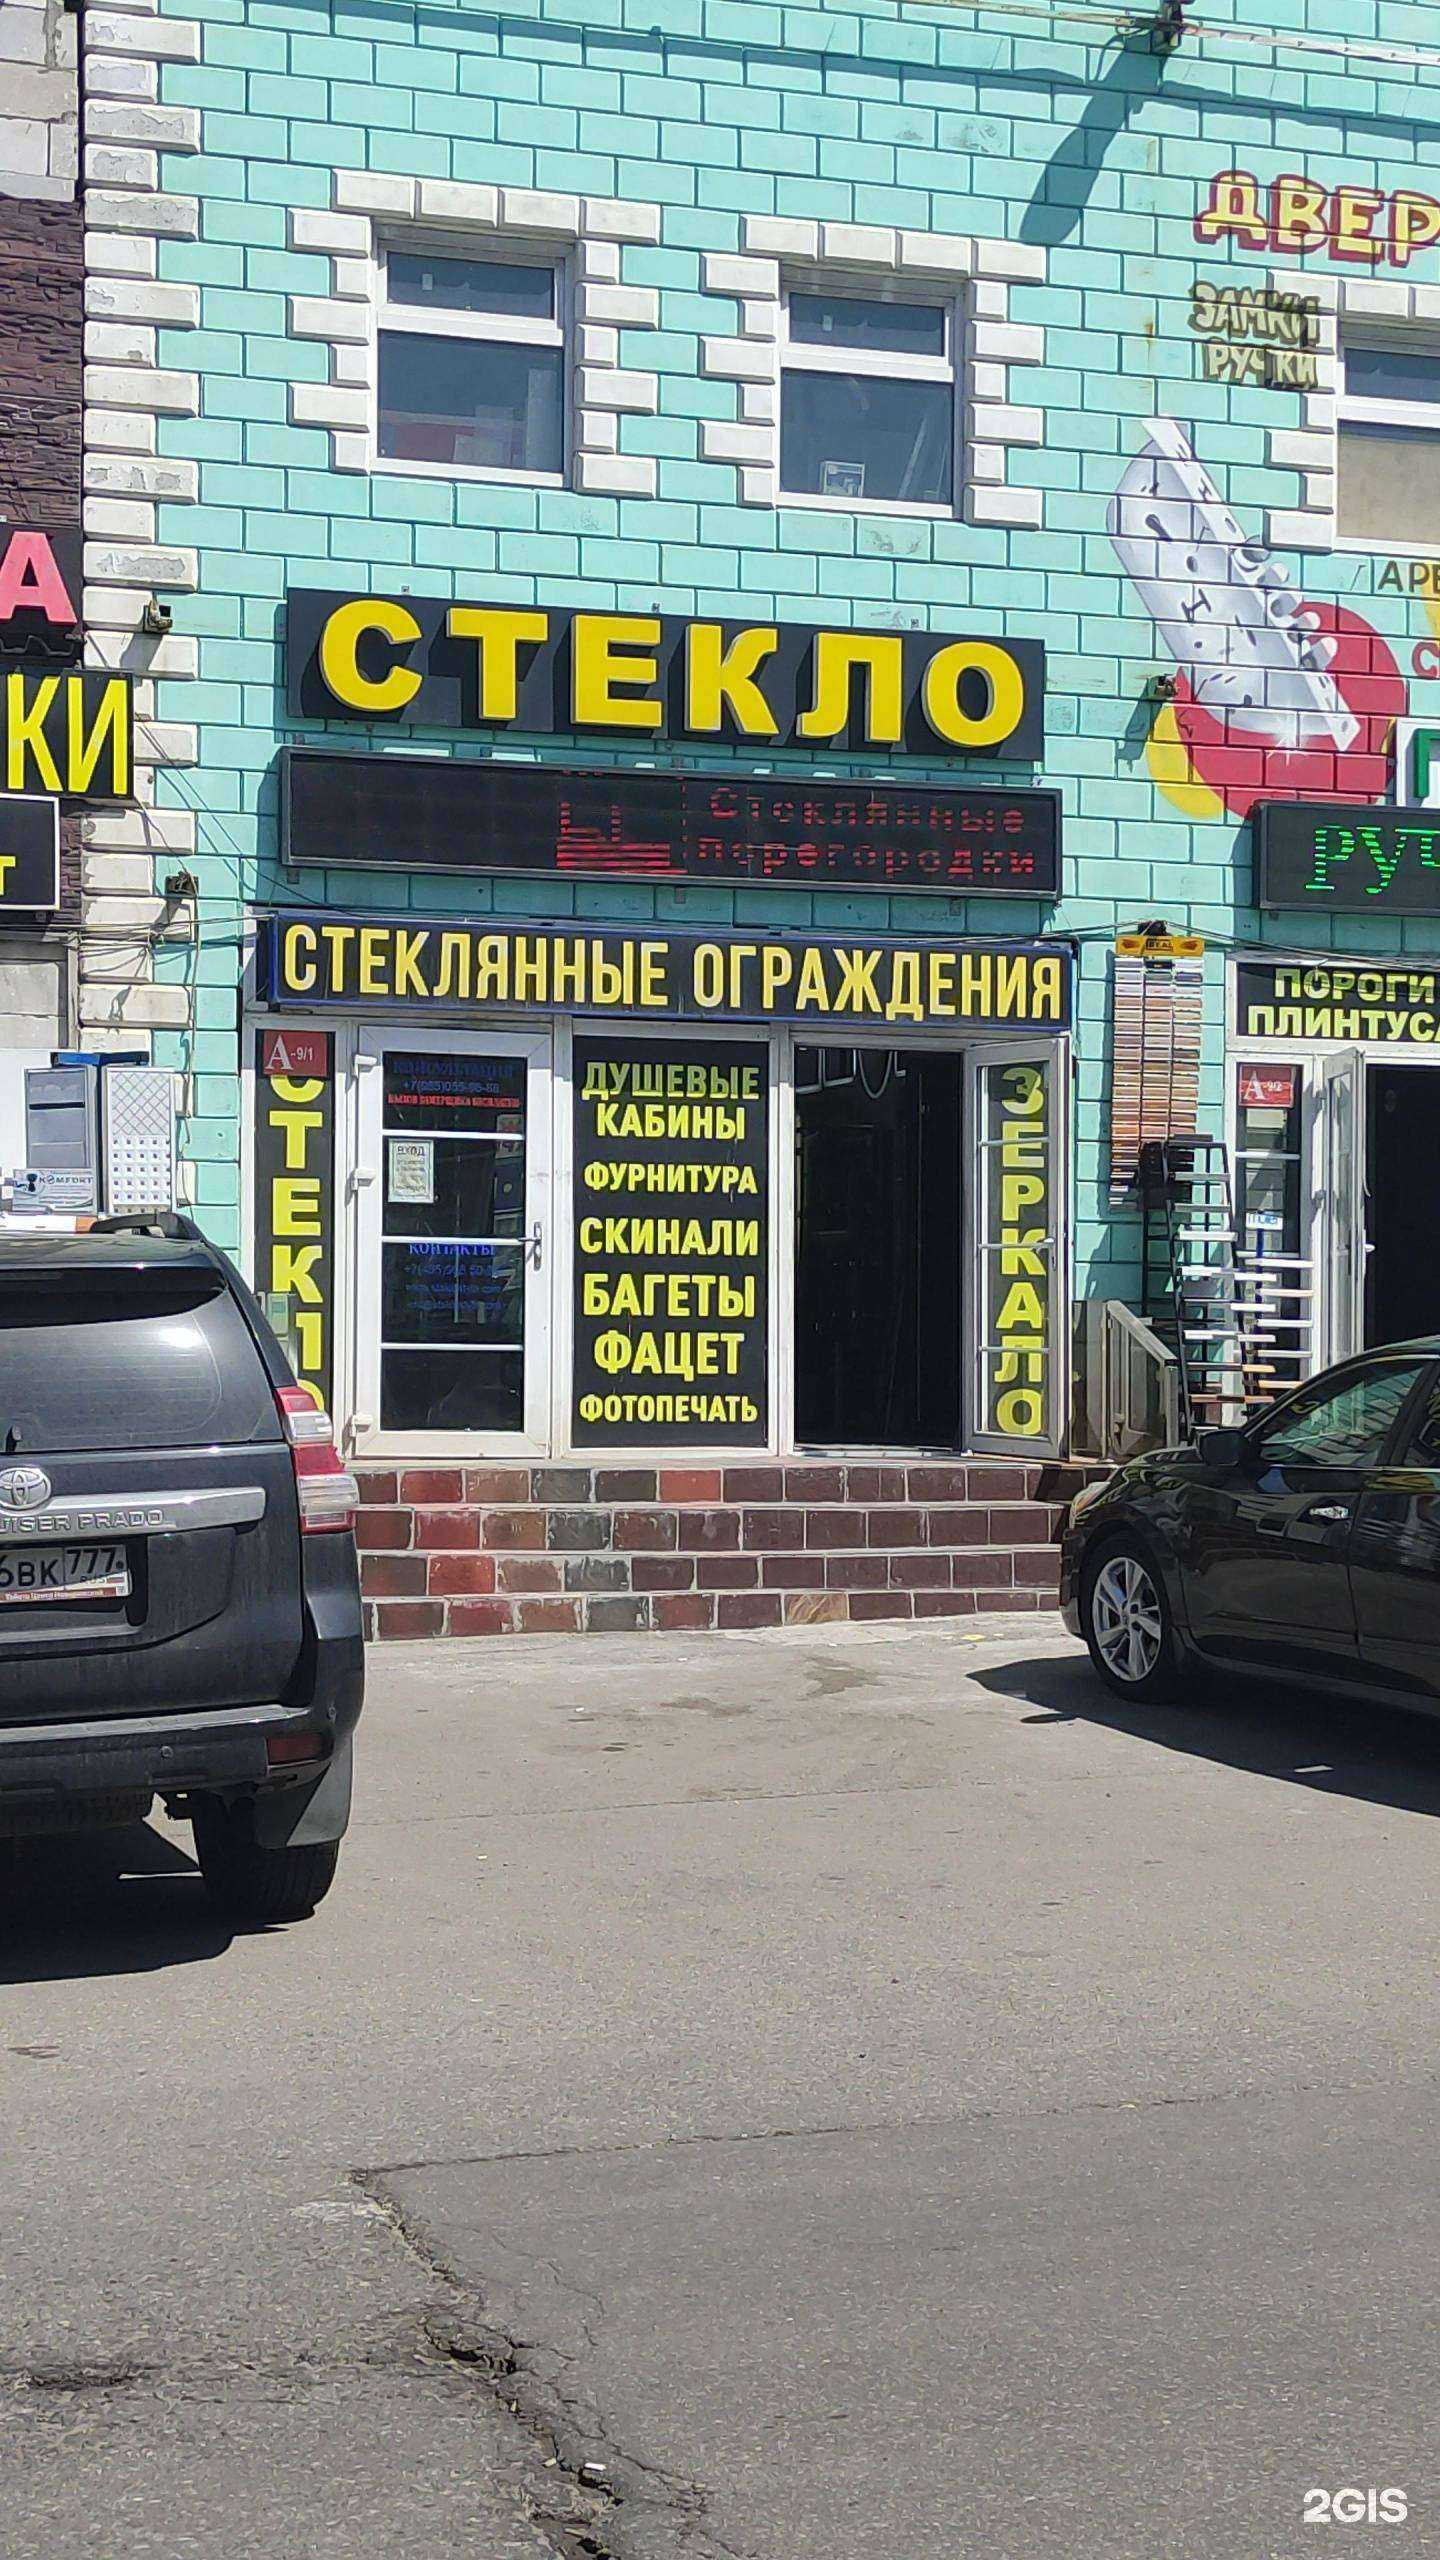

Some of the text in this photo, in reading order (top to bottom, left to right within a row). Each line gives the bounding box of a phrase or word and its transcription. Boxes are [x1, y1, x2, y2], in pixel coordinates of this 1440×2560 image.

[1187, 280, 1321, 347] ЗАМКИ
[1202, 337, 1319, 390] РУЧКИ
[319, 600, 1024, 748] СТЕКЛО
[7, 673, 128, 795] КИ
[284, 924, 1062, 1021] СТЕКЛЯННЫЕ ОГРАЖДЕНИЯ
[1274, 967, 1435, 1004] ПОРОГИ
[1248, 1005, 1440, 1042] ПЛИНТУС
[582, 1061, 760, 1101] ДУШЕВЫЕ
[596, 1103, 746, 1140] КАБИНЫ
[583, 1161, 758, 1195] ФУРНИТУРА
[579, 1217, 759, 1257] СКИНАЛИ
[994, 1067, 1047, 1435] ЗЕРКАЛО
[582, 1273, 756, 1318] БАГЕТЫ
[593, 1330, 745, 1382] ФАЦЕТ
[579, 1393, 758, 1424] ФОТОПЕЧАТЬ
[77, 1509, 164, 1530] PRADO
[66, 1547, 117, 1575] 777
